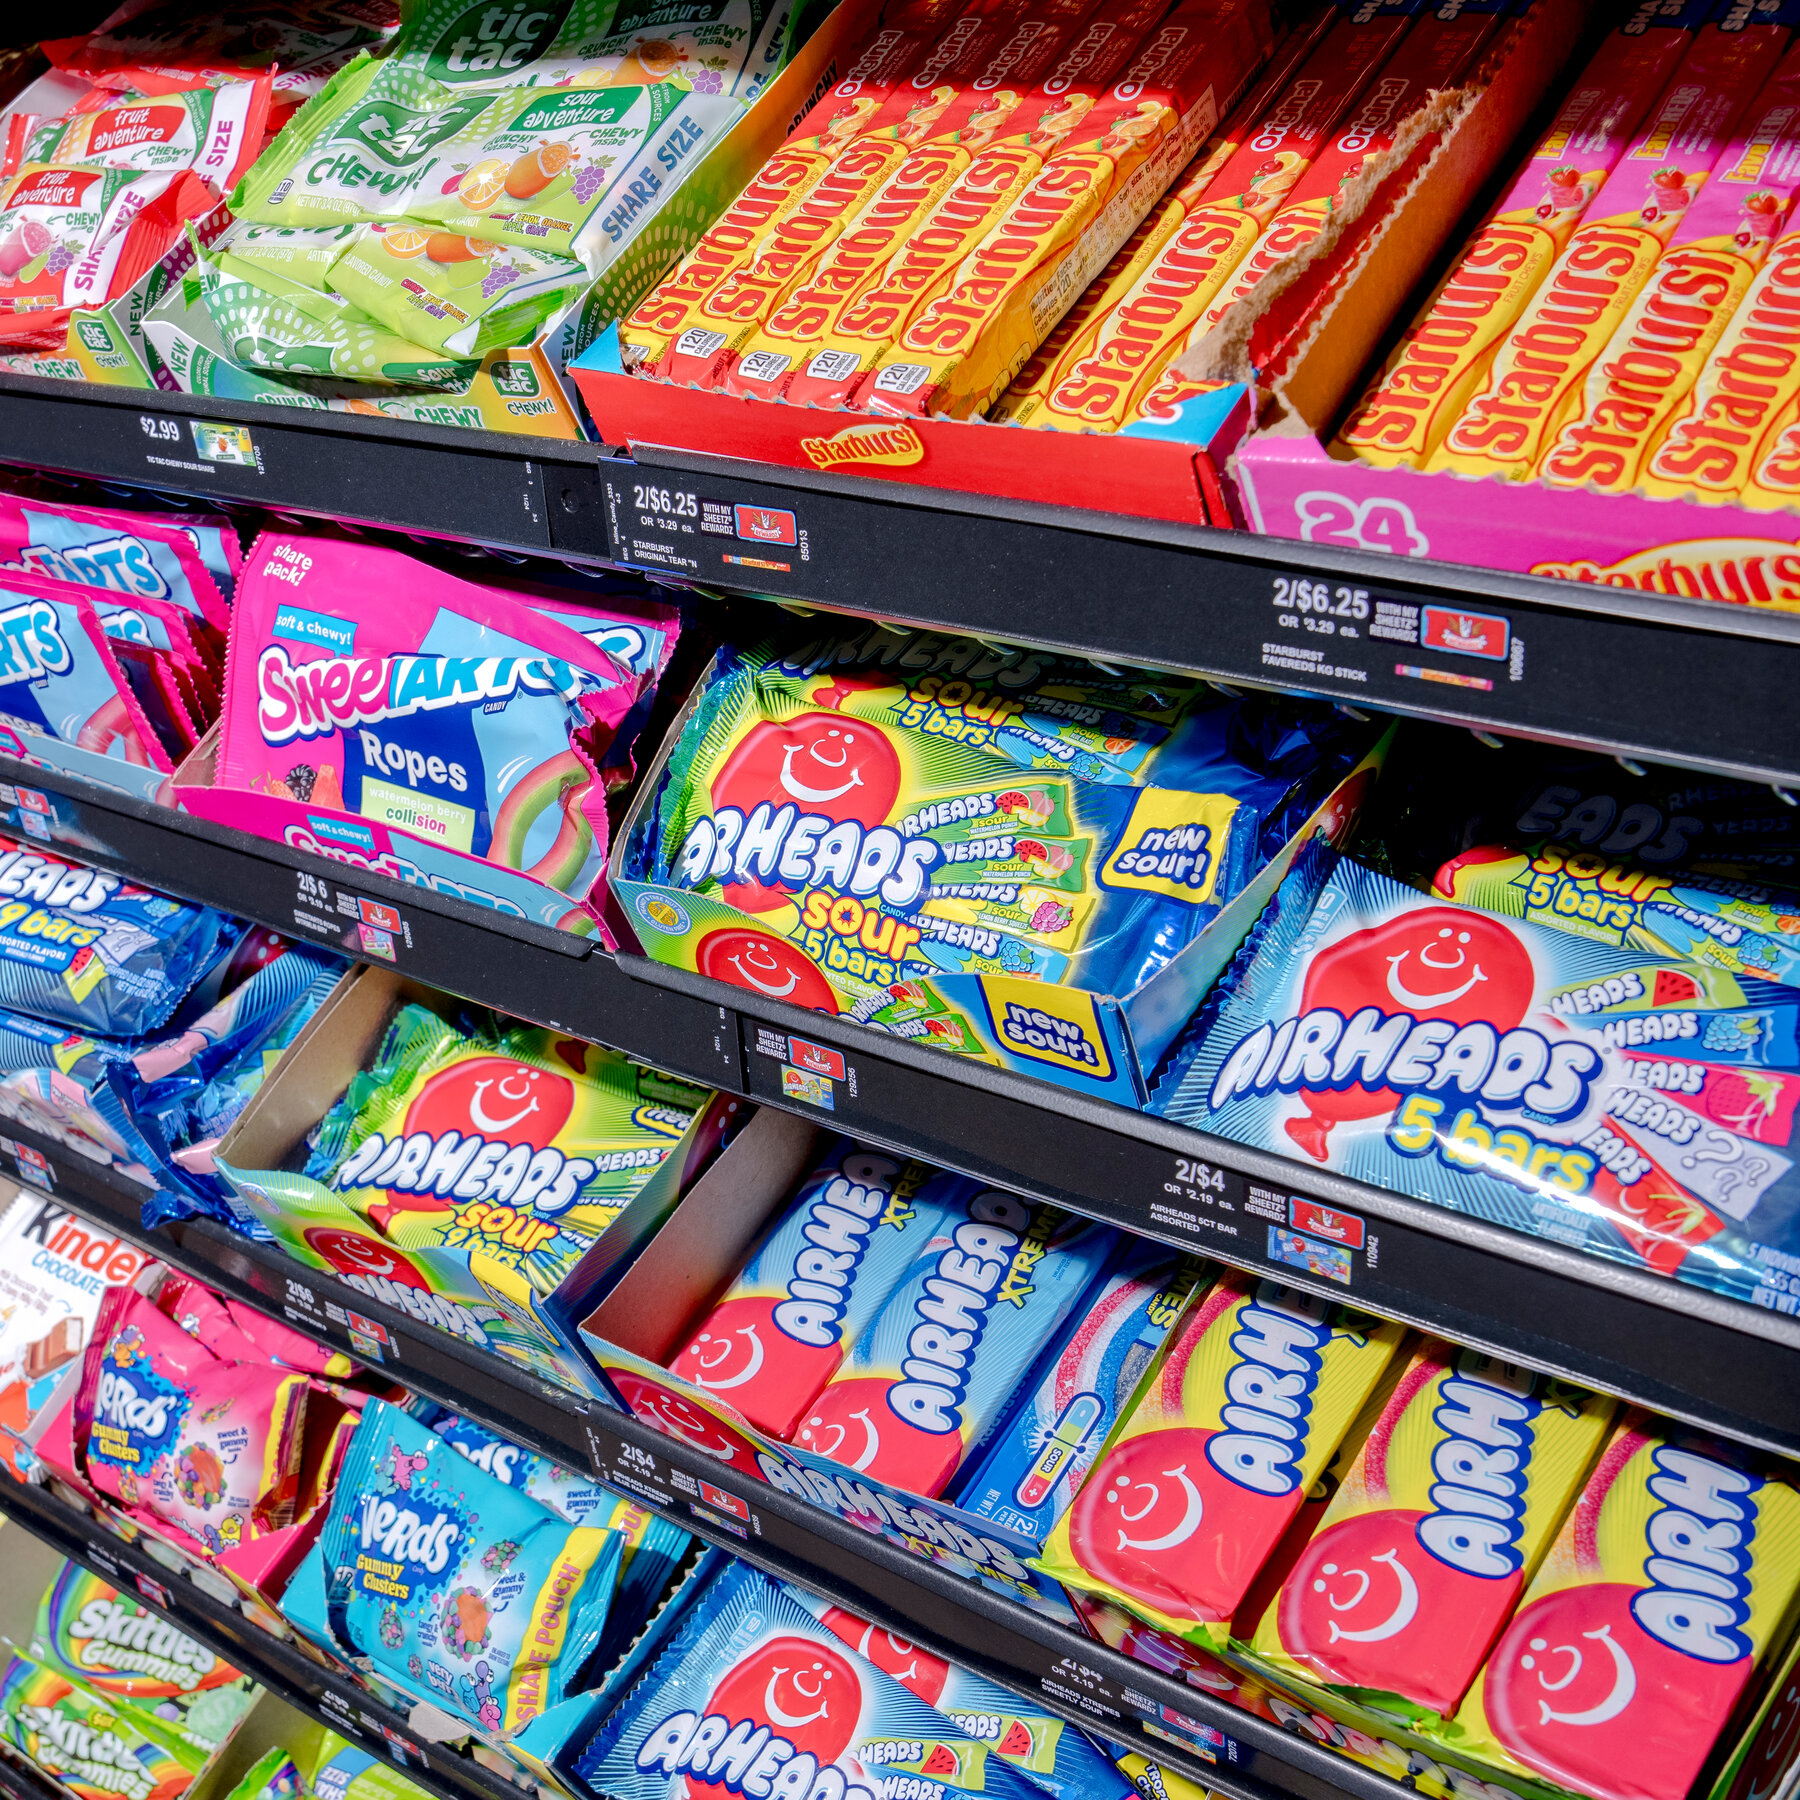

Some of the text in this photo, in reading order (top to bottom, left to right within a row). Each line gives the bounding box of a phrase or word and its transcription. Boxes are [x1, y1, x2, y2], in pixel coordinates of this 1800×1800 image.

[477, 7, 548, 40] tic
[692, 24, 748, 41] CHEWY
[446, 39, 535, 72] tac
[912, 18, 982, 89] Original
[1114, 27, 1188, 101] Original
[560, 90, 605, 109] sour
[115, 107, 150, 124] fruit
[523, 105, 616, 129] adventure
[1337, 78, 1410, 152] Original
[93, 124, 165, 147] adventure
[589, 127, 643, 140] CHEWY
[147, 146, 193, 158] CHEWY
[38, 171, 71, 186] fruit
[305, 153, 440, 197] CHEWY!
[601, 115, 704, 243] SHARE SIZE
[858, 160, 898, 204] FRUIT CHEWS
[12, 186, 76, 206] adventure
[65, 212, 101, 225] CHEWY
[706, 140, 900, 320] Starburst
[625, 152, 828, 334] Starburst
[768, 147, 956, 340] Starburst
[839, 149, 1030, 337] Starburst
[906, 155, 1100, 352] Starburst
[130, 292, 144, 336] NEW
[1052, 208, 1243, 422] Starburst
[82, 323, 104, 339] tic
[83, 335, 110, 349] tac
[681, 330, 706, 349] 120
[1353, 223, 1538, 452] Starburst
[94, 354, 128, 368] CHEWY!
[170, 337, 190, 377] NEW
[1453, 230, 1643, 463] Starburst
[501, 361, 530, 381] tic
[743, 353, 770, 375] 120
[812, 352, 839, 375] 120
[880, 366, 909, 388] 120
[1548, 252, 1737, 486] Starburst
[498, 378, 534, 393] tac
[414, 408, 483, 427] CHEWY
[507, 398, 556, 416] CHEWY!
[140, 416, 180, 441] $2.99
[804, 425, 918, 465] Starburst
[634, 486, 698, 517] 2/$6.25
[703, 503, 731, 515] WITH MY
[641, 516, 694, 533] OR $3.29 ea.
[701, 522, 733, 535] REWARDZ
[1297, 492, 1430, 556] 24
[273, 545, 313, 570] share
[634, 540, 674, 554] STARBURST
[635, 550, 668, 563] ORIGINAL
[669, 555, 687, 567] TEAR
[800, 529, 809, 561] 85013
[264, 562, 306, 588] pack!
[1272, 577, 1370, 619] 2/$6.25
[276, 614, 352, 646] soft & chewy!
[1278, 614, 1360, 638] OR $3.29 ea.
[1262, 643, 1325, 662] STARBURST
[1262, 655, 1367, 682] FAVEREDS KG STICK
[484, 701, 508, 714] CANDY
[910, 676, 1024, 728] sour
[901, 702, 992, 748] 5 bars
[360, 731, 468, 792] Ropes
[369, 786, 467, 824] watermelon berry
[385, 806, 447, 836] collision
[978, 815, 1008, 828] sour
[1141, 825, 1207, 852] new
[993, 863, 1023, 873] sour
[1118, 848, 1206, 884] sour!
[1532, 845, 1675, 903] sour
[992, 906, 1021, 920] sour
[1528, 874, 1635, 929] 5 bars
[18, 909, 102, 946] bars
[802, 890, 921, 962] sour
[1529, 911, 1619, 946] ASSORTED FLAVORS
[803, 929, 896, 985] 5 bars
[1009, 1003, 1080, 1041] new
[756, 1044, 787, 1060] REWARDZ
[1007, 1022, 1096, 1066] sour!
[1212, 1008, 1598, 1111] AIRHEADS
[848, 1067, 857, 1097] 129256
[1396, 1098, 1596, 1196] 5 bars
[339, 1130, 596, 1210] AIRHEADS
[1175, 1159, 1226, 1192] 2/$4
[1163, 1182, 1235, 1212] OR $2.19 ea.
[1249, 1186, 1286, 1204] WITH MY
[455, 1202, 559, 1252] sour
[1150, 1203, 1238, 1235] AIRHEADS 5CT BAR
[1150, 1212, 1200, 1232] ASSORTED
[1244, 1203, 1286, 1223] REWARDZ
[1366, 1235, 1379, 1269] 110942
[32, 1249, 104, 1295] CHOCOLATE
[92, 1424, 129, 1445] Gummy
[100, 1439, 140, 1462] Clusters
[620, 1443, 656, 1470] 2/$4
[1041, 1447, 1064, 1474] SOUR
[617, 1457, 630, 1468] OR
[632, 1463, 651, 1478] $2.19
[613, 1470, 674, 1502] AIRHEADS XTREMES
[614, 1476, 669, 1506] BLUE RASPBERRY
[759, 1453, 1020, 1579] AIRHEADS
[357, 1553, 404, 1582] Gummy
[363, 1573, 410, 1600] Clusters
[537, 1562, 581, 1646] POUCH
[70, 1599, 216, 1674] Skittles
[80, 1640, 203, 1691] Gummies
[1051, 1665, 1113, 1698] OR $2.19 ea.
[1041, 1677, 1121, 1718] AIRHEADS XTREMES
[1041, 1684, 1103, 1717] SWEETLY SOUR
[1120, 1694, 1157, 1716] REWARDZ
[1229, 1740, 1238, 1763] 72075
